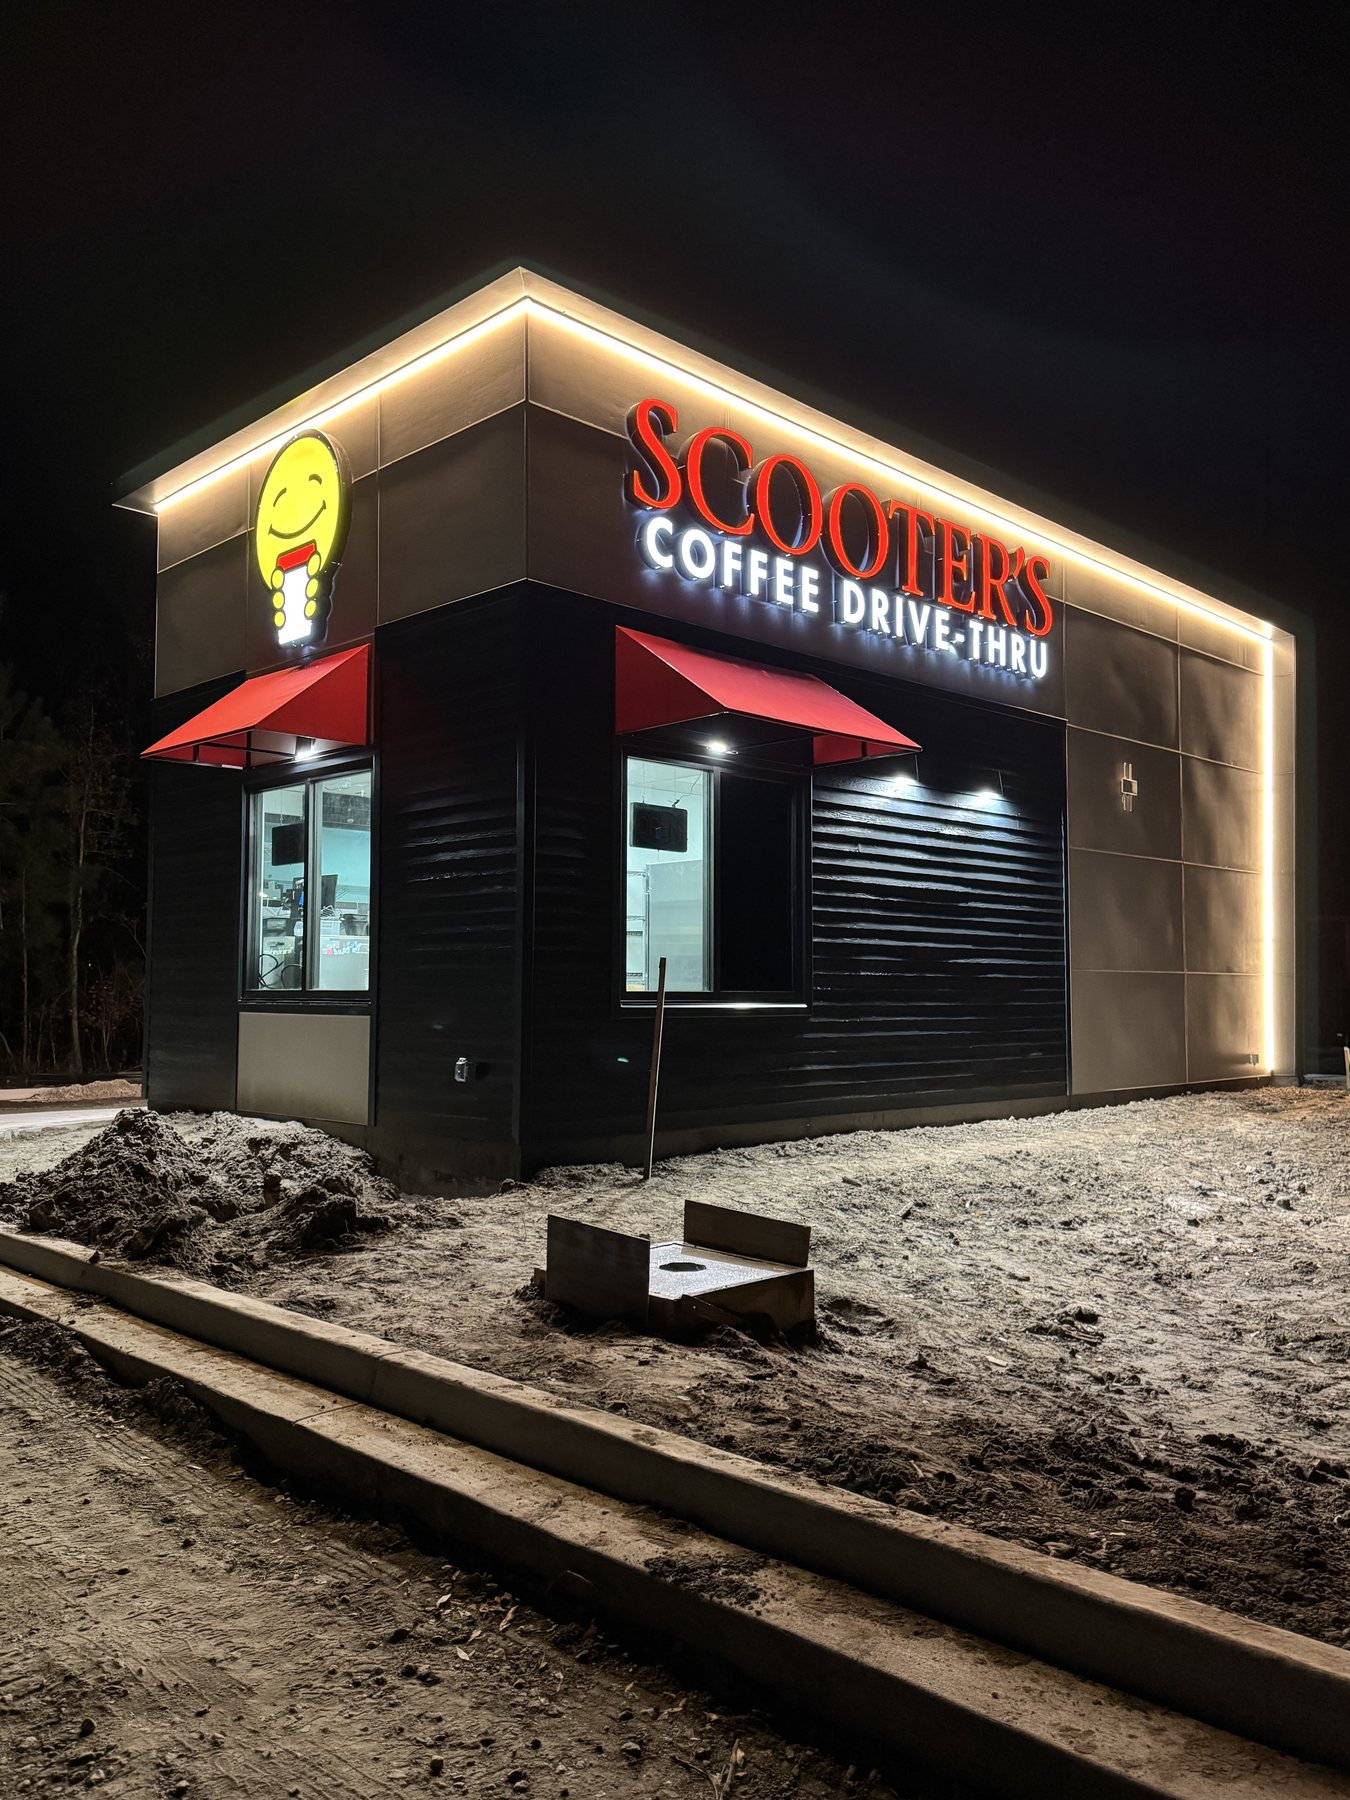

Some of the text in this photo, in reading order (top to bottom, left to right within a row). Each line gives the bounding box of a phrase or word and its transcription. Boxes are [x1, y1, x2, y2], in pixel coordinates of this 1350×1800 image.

[633, 398, 1053, 636] SCOOTER'S
[646, 516, 1048, 678] COFFEE DRIVE-THRU
